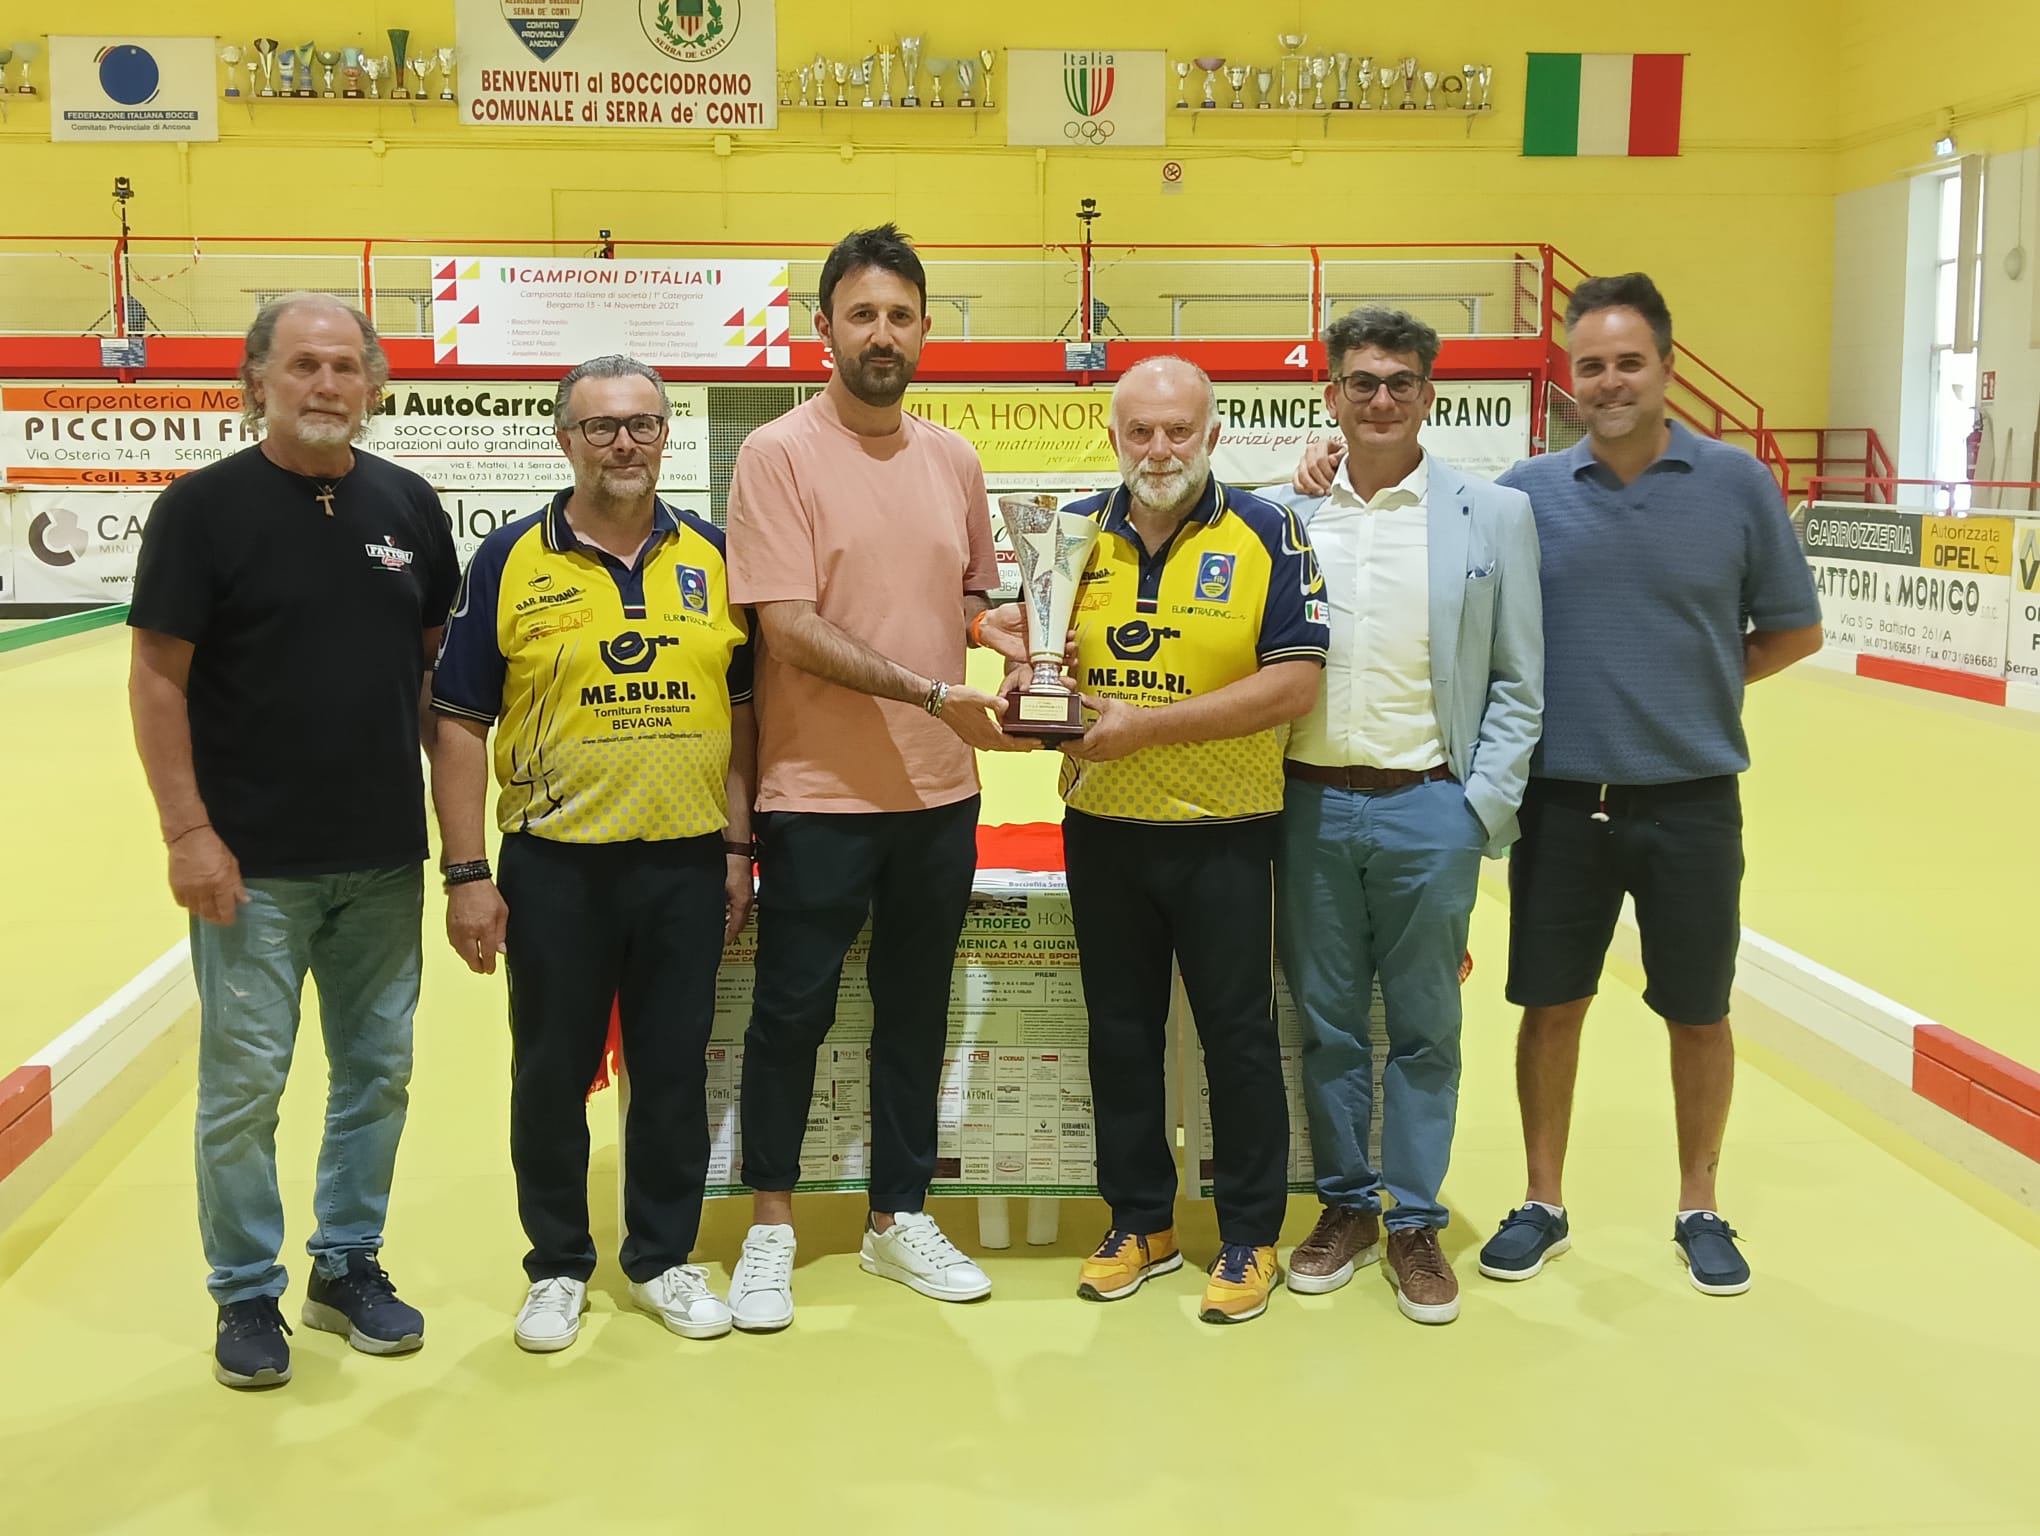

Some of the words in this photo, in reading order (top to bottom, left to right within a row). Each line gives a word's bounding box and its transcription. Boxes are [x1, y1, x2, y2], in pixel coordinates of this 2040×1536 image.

[654, 37, 682, 57] SERRA
[700, 38, 726, 56] CONTI
[1064, 52, 1114, 66] Italia
[481, 70, 579, 94] BENVENUTI
[588, 72, 602, 93] al
[611, 72, 752, 96] BOCCIODROMO
[67, 111, 126, 120] FEDERAZIONE
[127, 111, 164, 120] ITALIANA
[165, 111, 195, 120] BOCCE
[472, 98, 574, 122] COMUNALE
[582, 99, 598, 122] di
[606, 100, 662, 123] SERRA
[706, 103, 764, 124] CONTI
[520, 269, 618, 284] CAMPIONI
[624, 270, 703, 284] D'ITALIA
[520, 290, 572, 300] Campionato
[662, 292, 704, 300] Categoria
[546, 301, 584, 310] Bergamo
[614, 302, 657, 310] Novembre
[1284, 344, 1309, 368] 4
[43, 390, 191, 414] Carpenteria
[200, 391, 240, 409] Me
[404, 392, 555, 416] AutoCarro
[25, 417, 200, 441] PICCIONI
[394, 425, 494, 436] soccorso
[368, 438, 442, 451] riparazioni
[446, 439, 480, 450] auto
[484, 438, 562, 452] grandinate
[995, 436, 1082, 450] matrimoni
[1085, 441, 1094, 450] e
[1272, 435, 1301, 452] per
[26, 449, 49, 460] Via
[54, 448, 110, 460] Osteria
[116, 449, 150, 460] 74-A
[176, 449, 222, 460] SERRA
[81, 472, 127, 482] Cell.
[136, 472, 176, 482] 334
[97, 514, 144, 541] CA
[1930, 523, 2000, 542] Autorizzata
[1806, 518, 1914, 555] CARROZZERIA
[1934, 544, 1980, 570] OPEL
[516, 598, 536, 611] BAR
[539, 586, 580, 603] MEVANIA
[1896, 574, 1980, 616] MORICO
[1172, 605, 1232, 619] EUROTRADING
[1840, 614, 1856, 627] Via
[2006, 660, 2038, 676] Serra
[1088, 668, 1192, 695] ME.BU.RI.
[580, 681, 697, 706] ME.BU.RI.
[1097, 690, 1138, 700] Tornitura
[594, 706, 642, 718] Tornitura
[644, 704, 690, 714] Fresatura
[612, 717, 672, 730] BEVAGNA
[1013, 940, 1028, 948] 14
